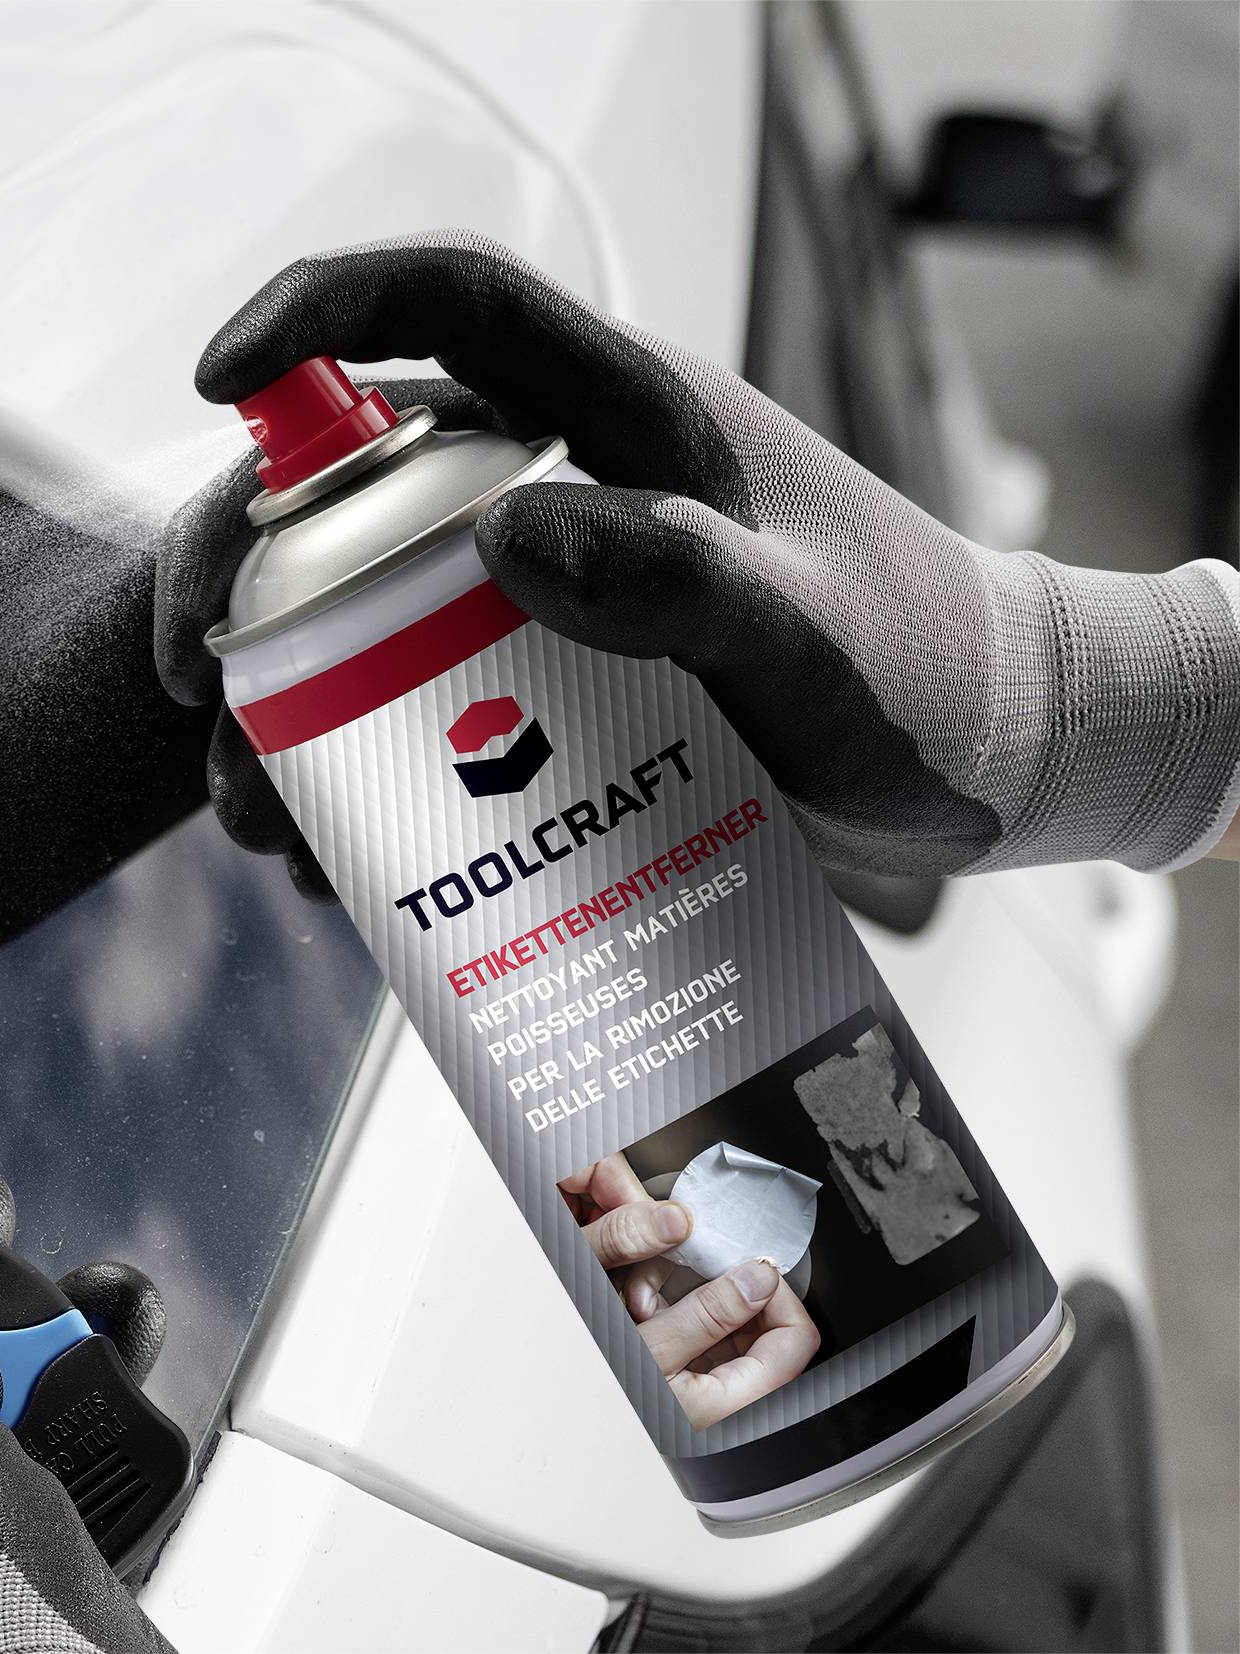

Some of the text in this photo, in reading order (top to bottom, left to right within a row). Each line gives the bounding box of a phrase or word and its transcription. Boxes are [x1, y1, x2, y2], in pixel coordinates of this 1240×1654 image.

[394, 737, 695, 932] TOOLCRAFT
[445, 797, 769, 998] ETIKETTENENTFERNER
[468, 863, 749, 1034] NETTOYANT MATIÈRES
[487, 967, 649, 1066] POISSEUSES
[507, 958, 742, 1101] PER LA RIMOZIONE
[525, 1000, 744, 1133] DELLE ETICHETTE
[44, 1390, 109, 1446] SHARP
